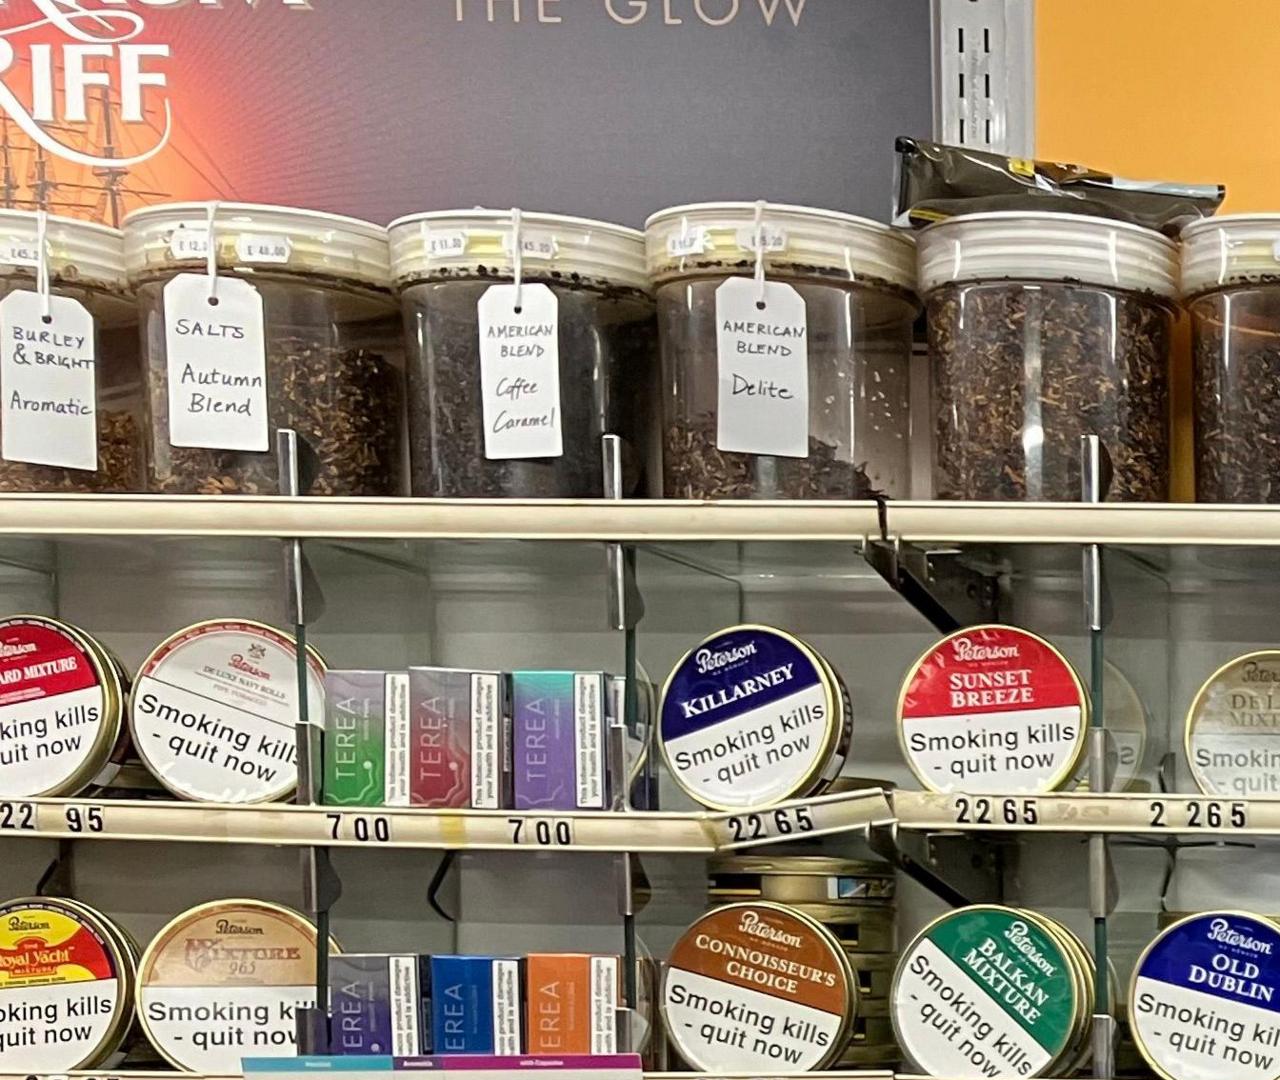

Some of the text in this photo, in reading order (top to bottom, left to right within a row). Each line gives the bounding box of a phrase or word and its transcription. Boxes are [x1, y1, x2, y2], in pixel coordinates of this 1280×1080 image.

[13, 325, 85, 350] BURLEY
[175, 318, 245, 341] SALTS
[487, 321, 555, 341] AMERICAN
[723, 319, 806, 340] AMERICAN
[499, 342, 546, 360] BLEND
[736, 340, 793, 358] BLEND
[181, 362, 264, 389] Autumn
[496, 377, 539, 399] Coffee
[732, 373, 795, 402] Delite
[187, 394, 252, 418] Blend
[695, 641, 757, 671] Peterson
[953, 636, 1020, 662] Peterson
[681, 662, 795, 719] KILLARNEY
[949, 669, 1032, 690] SUNSET
[950, 686, 1033, 708] BREEZE
[909, 722, 1076, 755] Smoking kills
[950, 751, 1055, 779] quit now
[694, 933, 837, 987] CONNOISSEUR'S
[978, 939, 1049, 1006] BALKAN
[1211, 953, 1260, 980] OLD
[725, 960, 798, 995] CHOICE
[962, 955, 1040, 1026] MIXTURE
[1188, 964, 1273, 1003] DUBLIN
